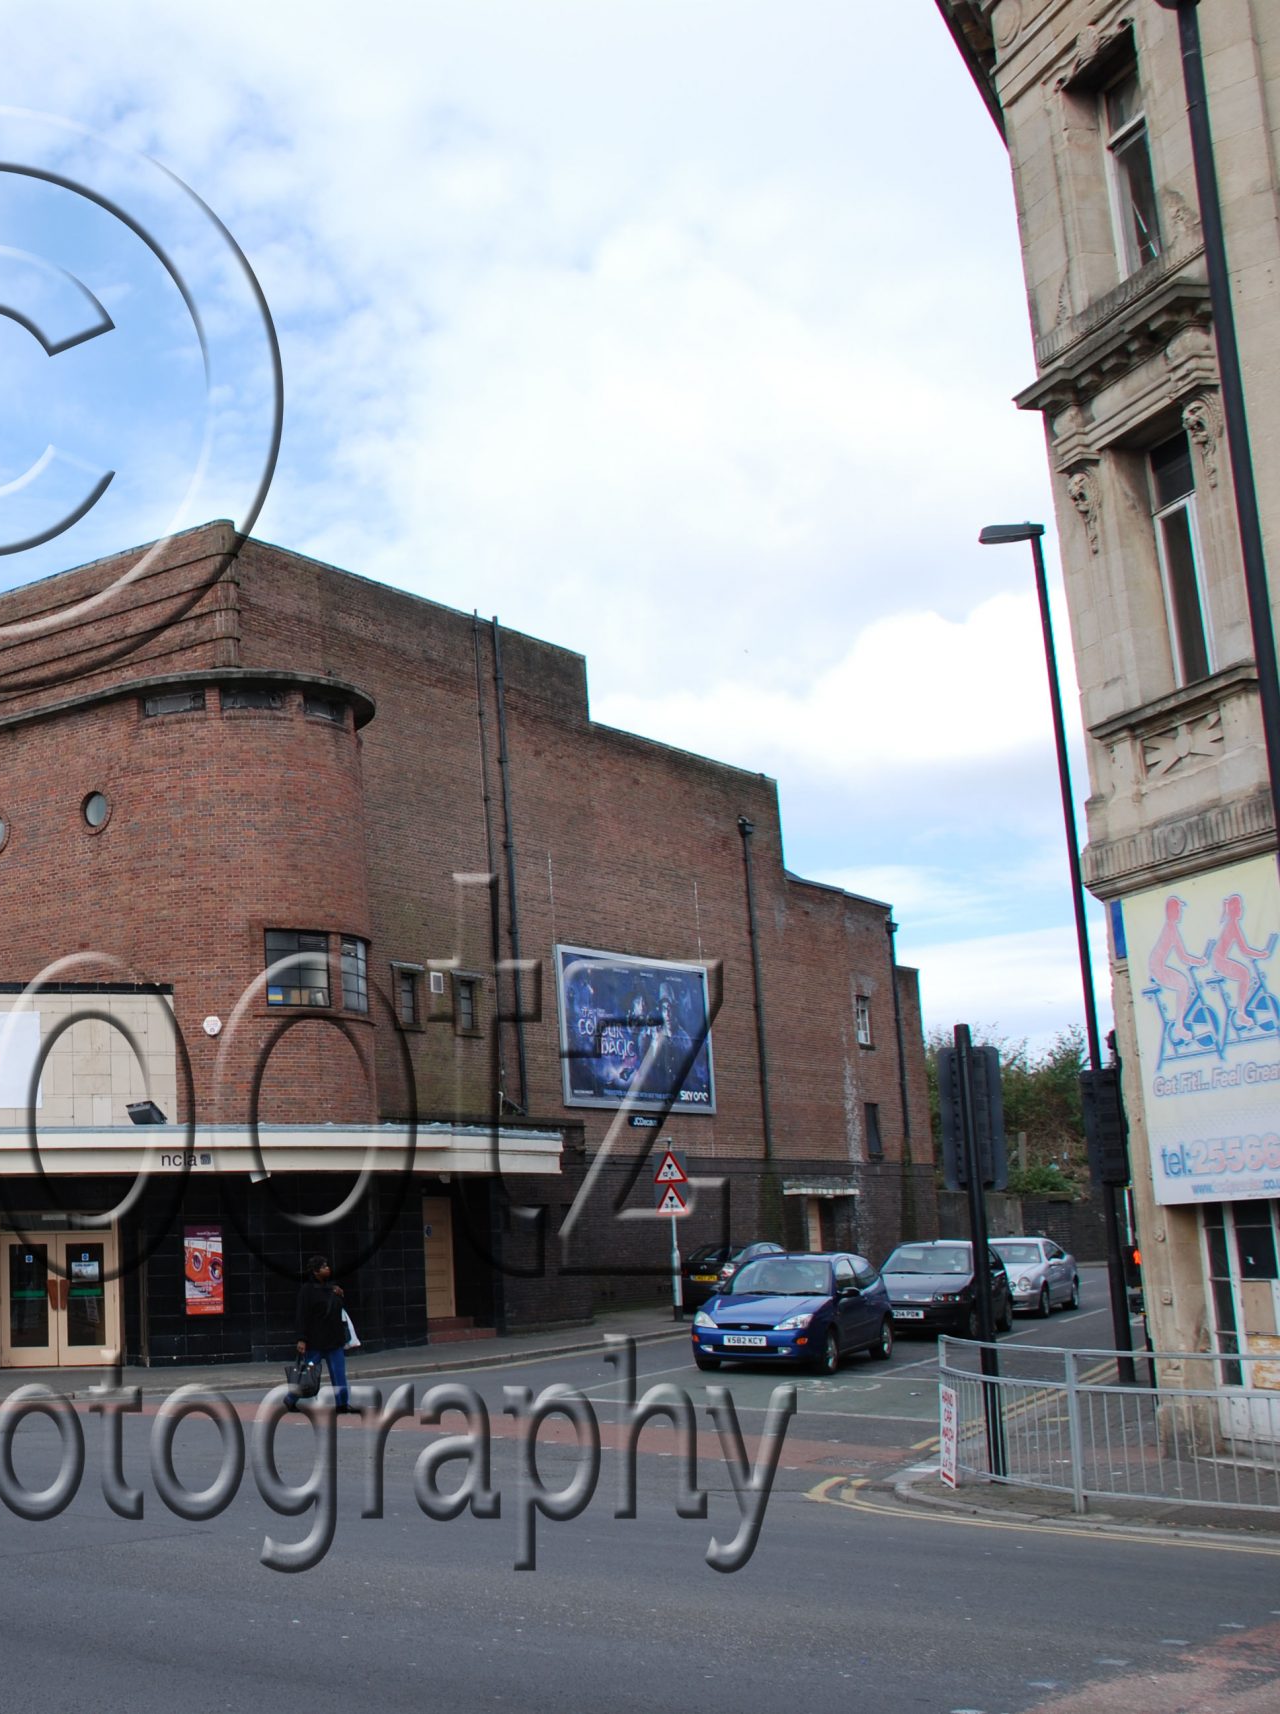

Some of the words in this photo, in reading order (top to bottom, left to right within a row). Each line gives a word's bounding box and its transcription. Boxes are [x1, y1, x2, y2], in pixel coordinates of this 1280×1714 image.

[1153, 1075, 1178, 1097] Get
[1212, 1064, 1241, 1088] Feel
[161, 1151, 198, 1167] ncla
